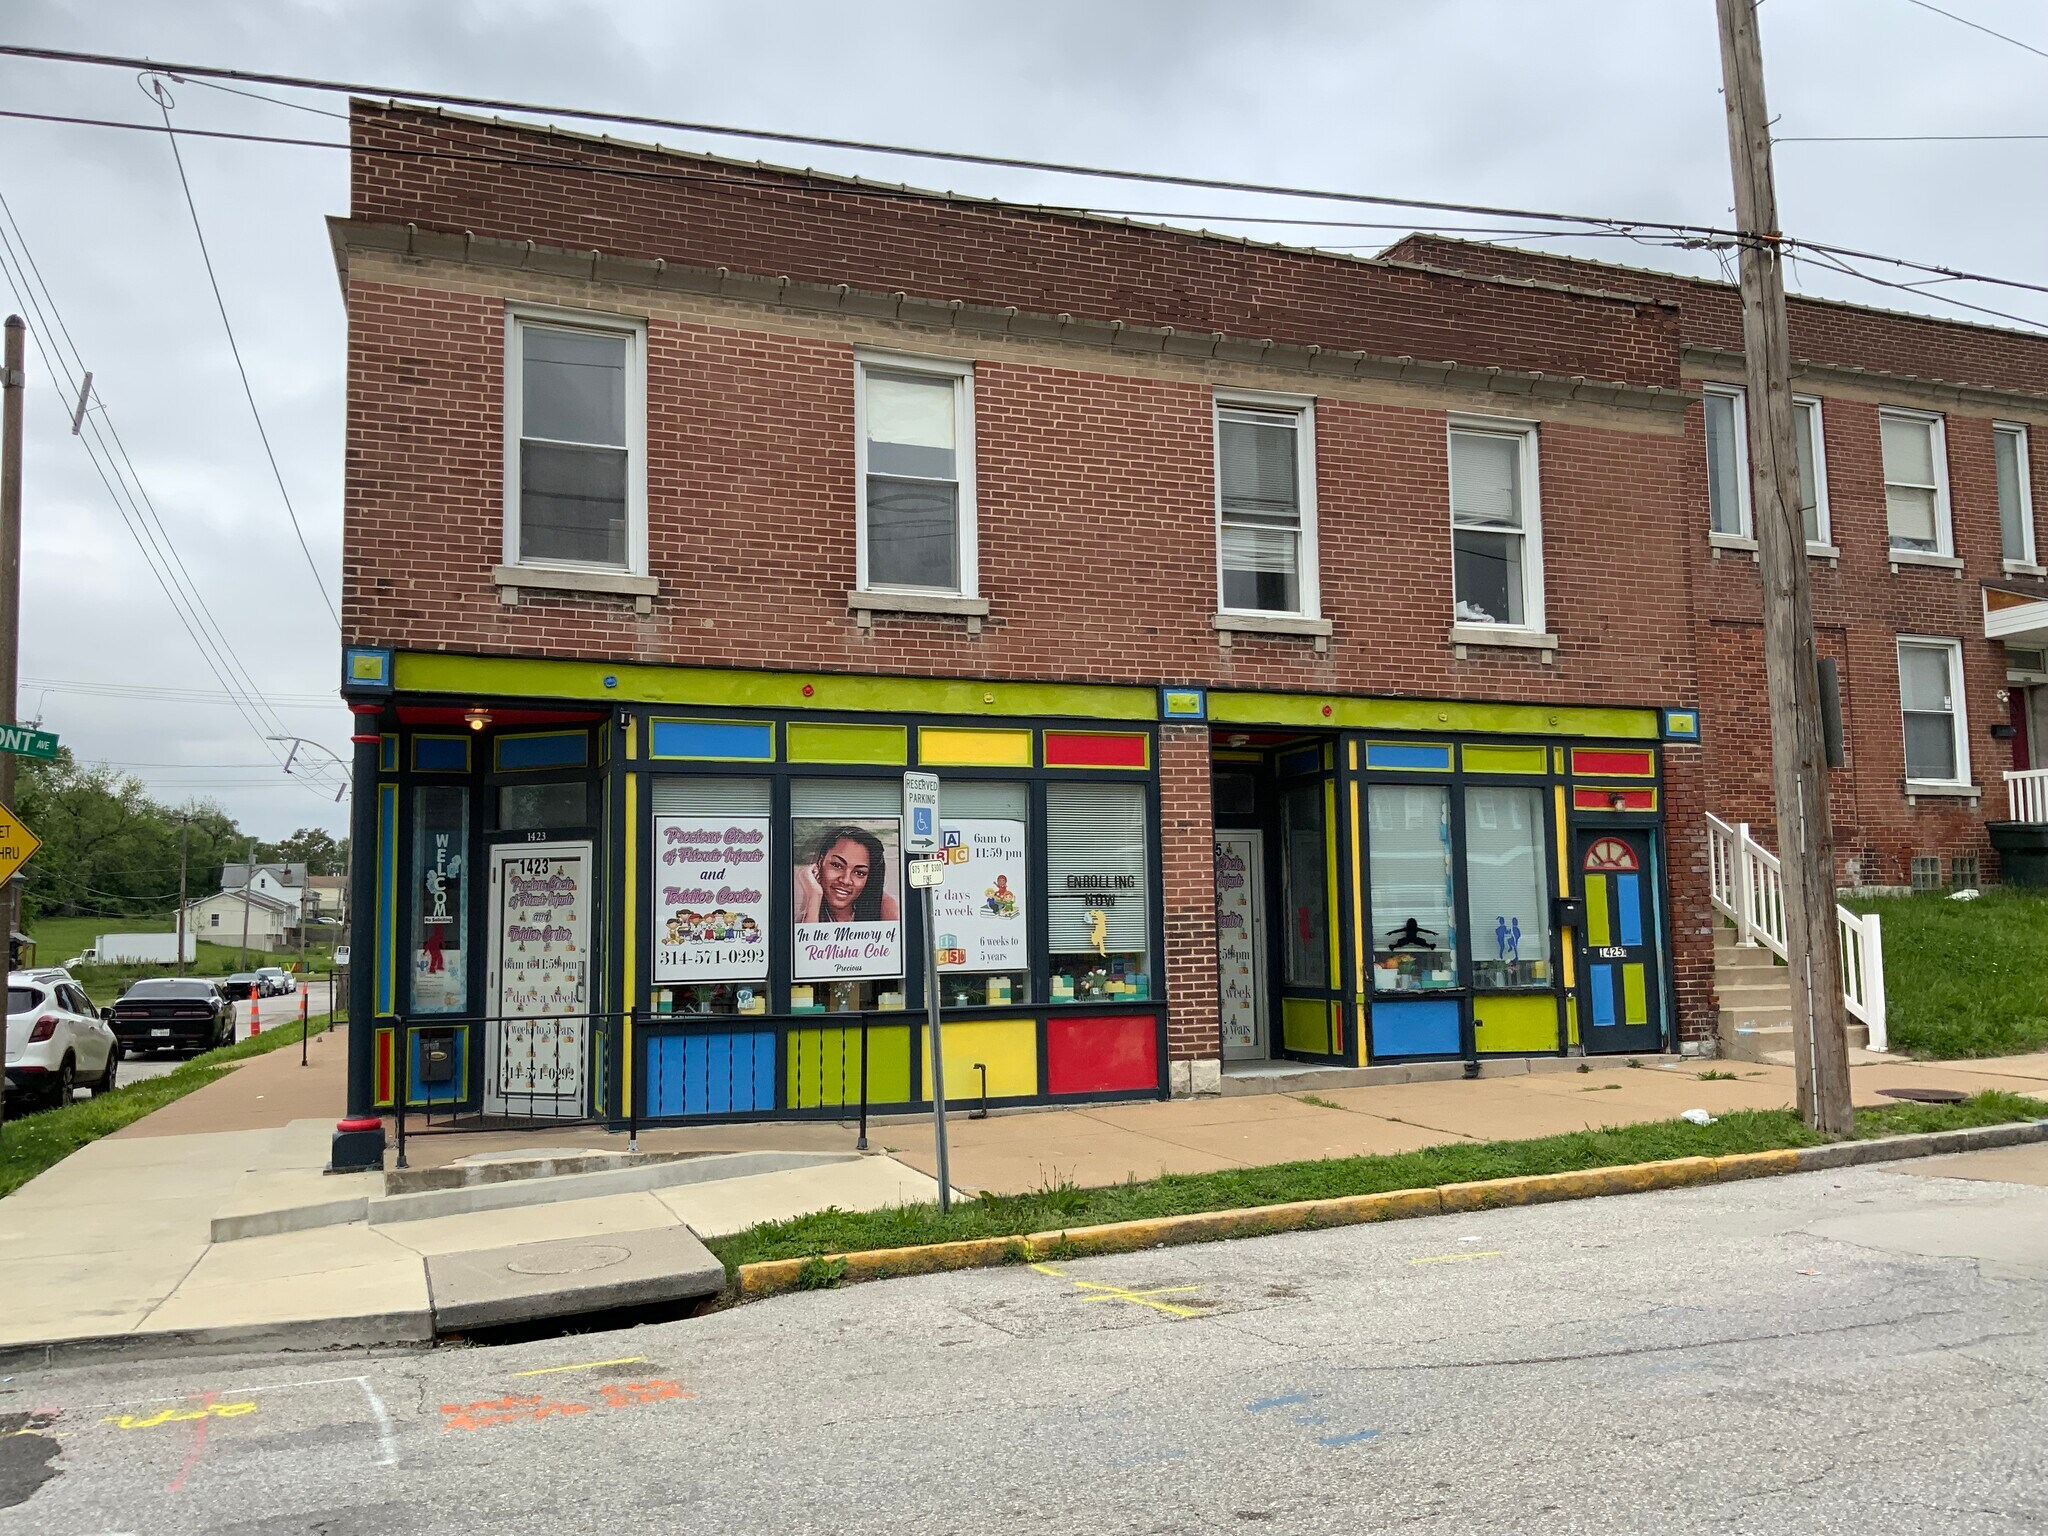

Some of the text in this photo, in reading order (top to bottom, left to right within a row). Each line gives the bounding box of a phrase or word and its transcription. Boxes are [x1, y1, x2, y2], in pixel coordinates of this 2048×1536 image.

[36, 740, 50, 750] AVE
[906, 778, 938, 791] RESERVED
[908, 792, 936, 804] PARKING
[527, 832, 546, 841] 1423
[663, 826, 722, 845] Precious
[974, 832, 1011, 843] 6am to
[975, 847, 1022, 860] 11:59 pm
[520, 858, 549, 875] 1423
[700, 868, 726, 880] and
[1066, 875, 1135, 888] ENROLLING
[662, 886, 762, 905] Toddler Center
[934, 889, 971, 903] 7 days
[1085, 894, 1115, 907] NOW
[934, 905, 974, 916] a week
[797, 927, 896, 943] In the Memory of
[987, 936, 1010, 945] weeks
[1011, 935, 1019, 945] to
[660, 949, 764, 966] 314-571-0292
[805, 943, 890, 960] RaNisha Cole
[987, 952, 1007, 964] years
[1236, 950, 1250, 963] pm
[562, 962, 577, 972] pm
[834, 963, 862, 972] Precious
[512, 990, 537, 1004] days
[1226, 985, 1251, 999] week
